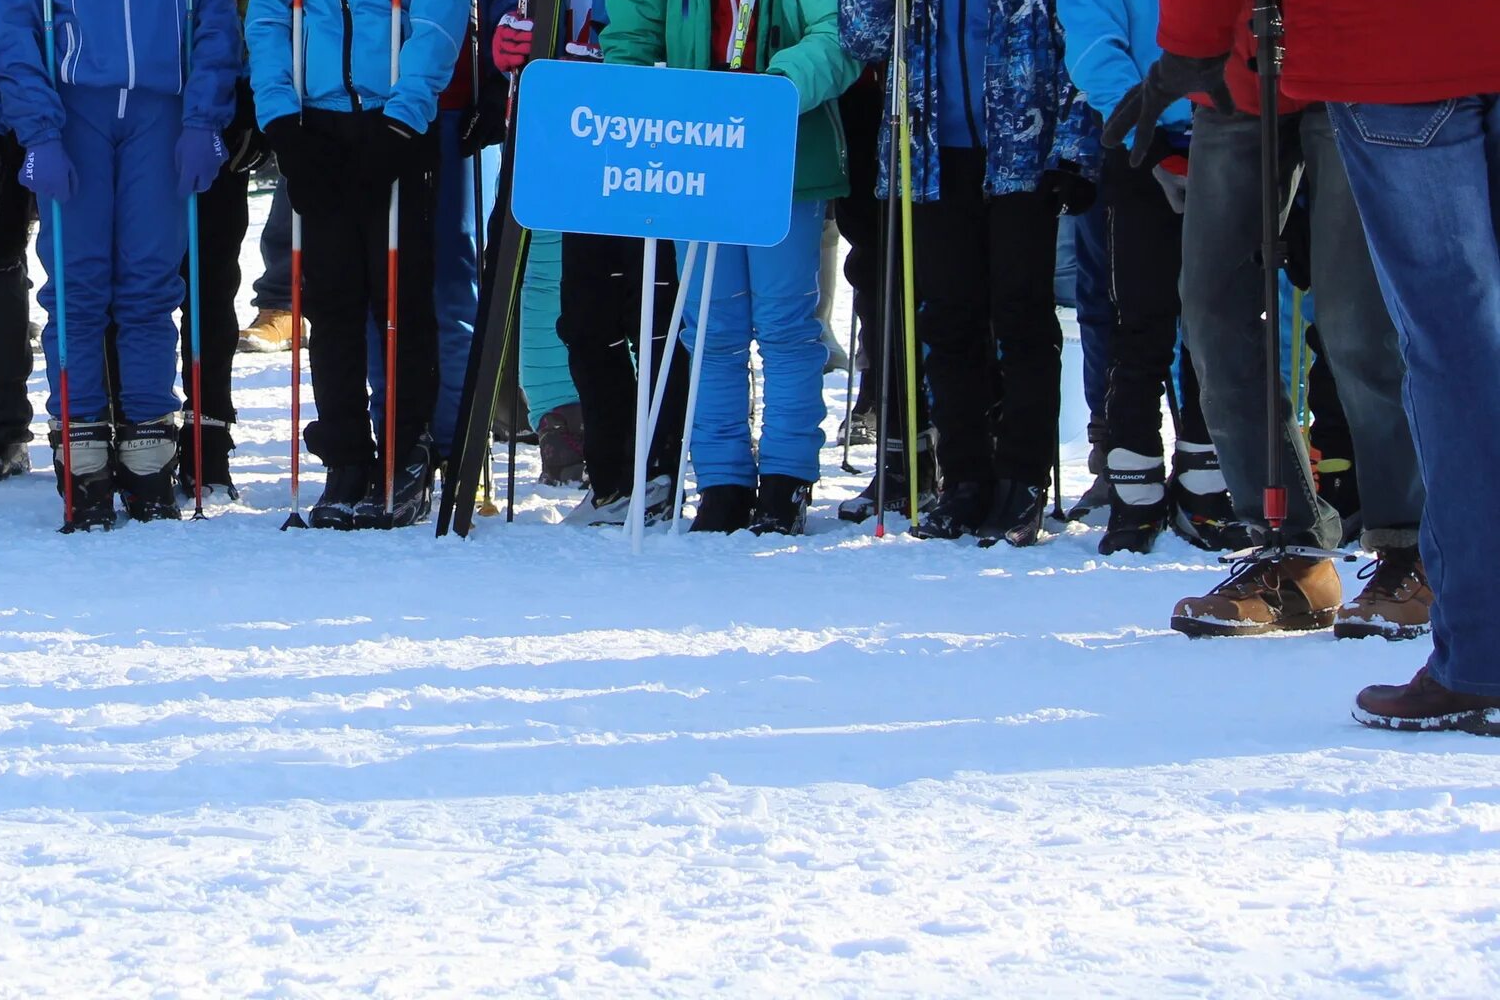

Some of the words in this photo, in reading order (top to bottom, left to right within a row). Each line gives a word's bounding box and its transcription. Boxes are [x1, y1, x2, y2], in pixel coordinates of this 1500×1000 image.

[570, 106, 745, 148] Сузунский
[25, 151, 35, 181] SPORT
[602, 161, 705, 197] район
